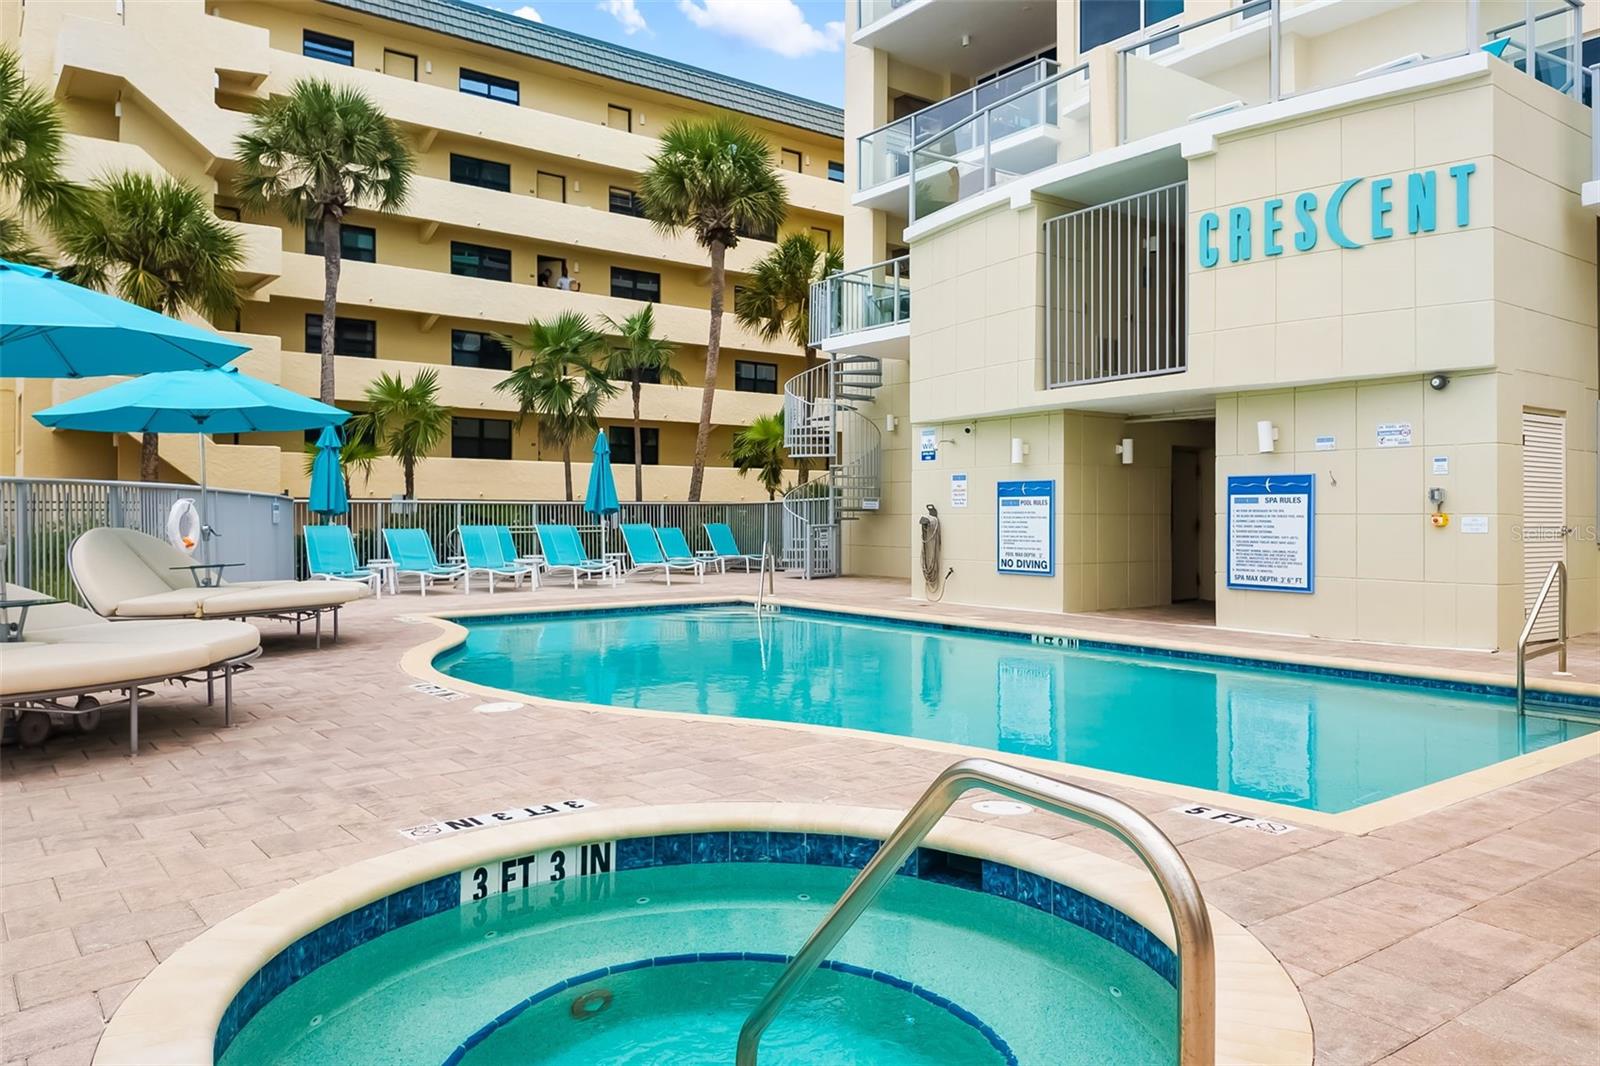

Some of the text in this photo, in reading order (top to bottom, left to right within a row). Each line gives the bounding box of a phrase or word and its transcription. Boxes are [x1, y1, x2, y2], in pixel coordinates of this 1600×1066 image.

[1199, 162, 1476, 268] CRESCENT
[1279, 496, 1302, 504] RULES
[1001, 558, 1048, 569] NO DIVING
[445, 800, 584, 831] 3 FT 3 IN
[1184, 807, 1255, 824] 5 FT
[472, 842, 611, 900] 3 FT 3 IN
